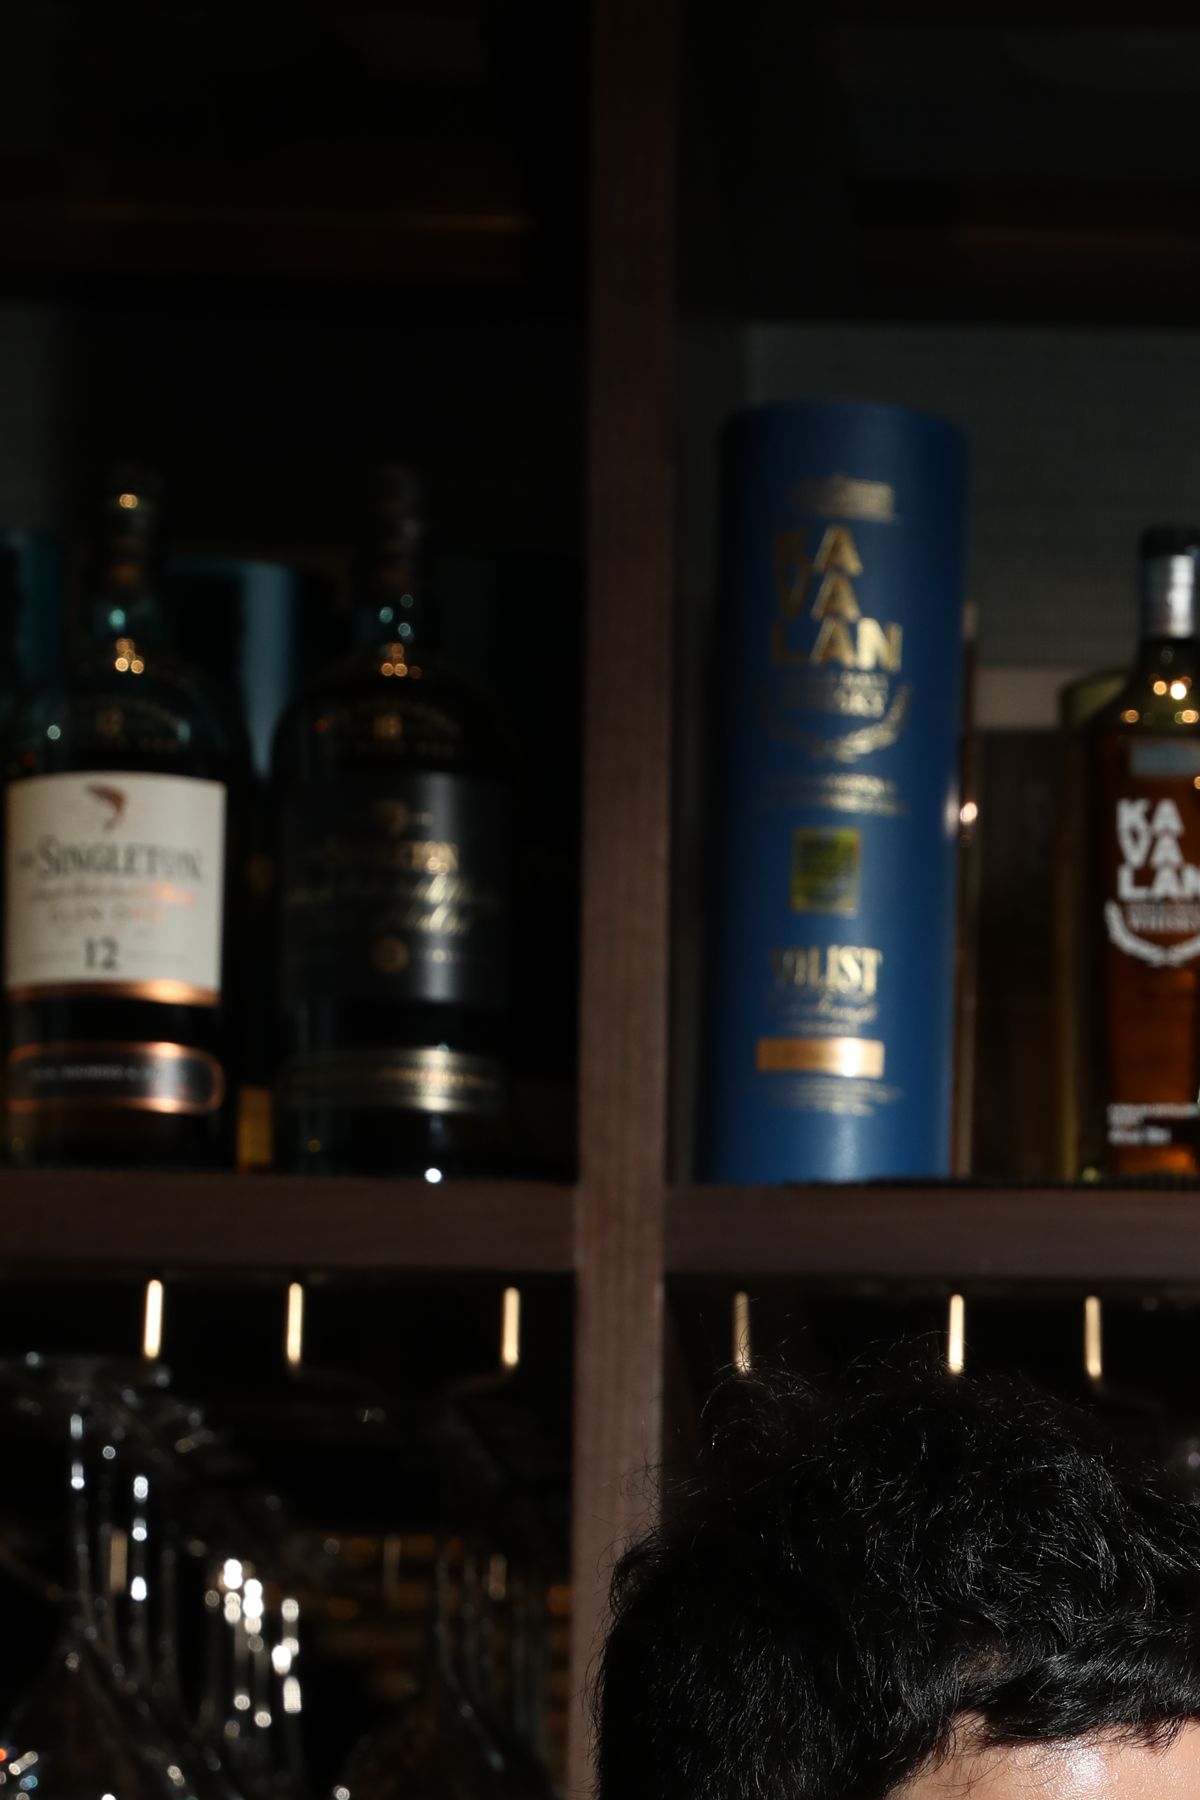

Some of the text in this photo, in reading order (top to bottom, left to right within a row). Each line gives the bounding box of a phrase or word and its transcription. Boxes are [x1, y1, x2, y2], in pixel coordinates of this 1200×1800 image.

[772, 616, 903, 671] LAN
[1116, 798, 1184, 834] KA
[1117, 829, 1184, 868] VA
[84, 936, 119, 970] 12
